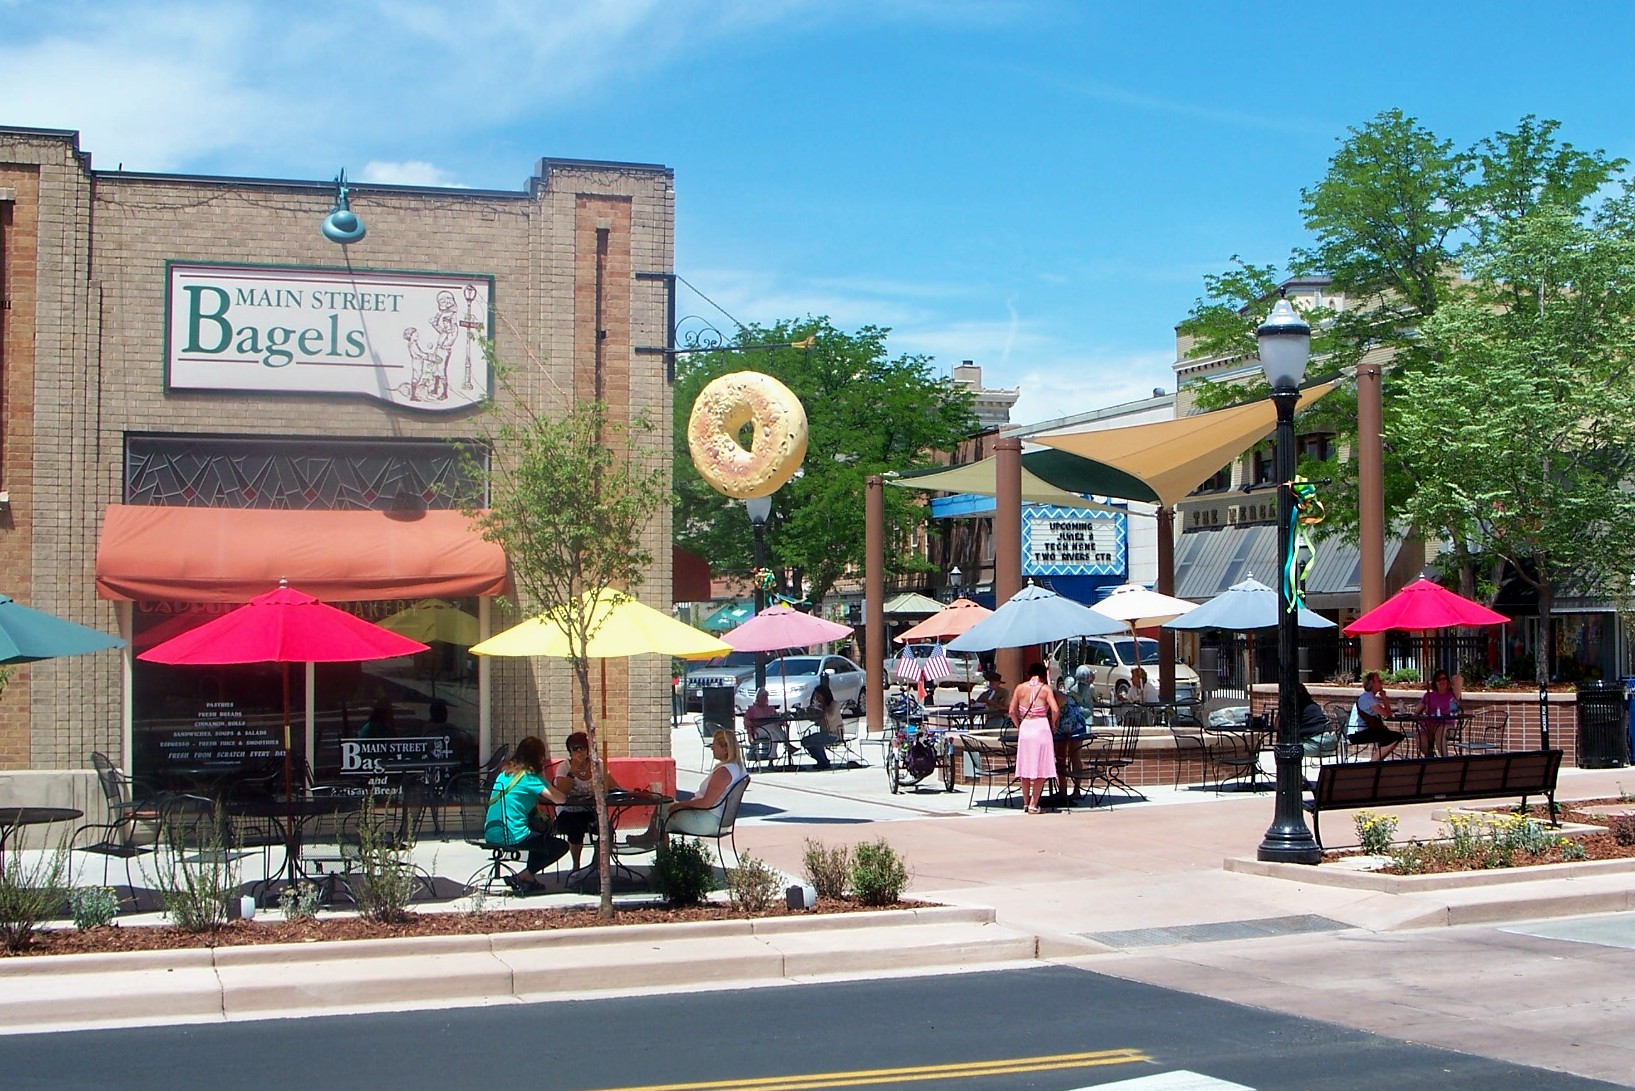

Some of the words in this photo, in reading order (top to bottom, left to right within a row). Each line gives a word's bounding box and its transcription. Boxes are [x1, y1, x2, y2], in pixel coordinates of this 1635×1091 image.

[235, 287, 303, 309] MAIN
[311, 290, 404, 313] STREET
[181, 285, 366, 368] Bagels
[1049, 522, 1093, 531] UPCOMING
[1044, 542, 1069, 551] TECH
[1035, 552, 1056, 561] TWO
[1061, 552, 1090, 561] RIVERS
[1095, 552, 1112, 561] CTR
[361, 743, 388, 754] MAIN
[389, 742, 428, 753] STREET
[193, 751, 212, 759] FROM
[368, 776, 388, 785] and
